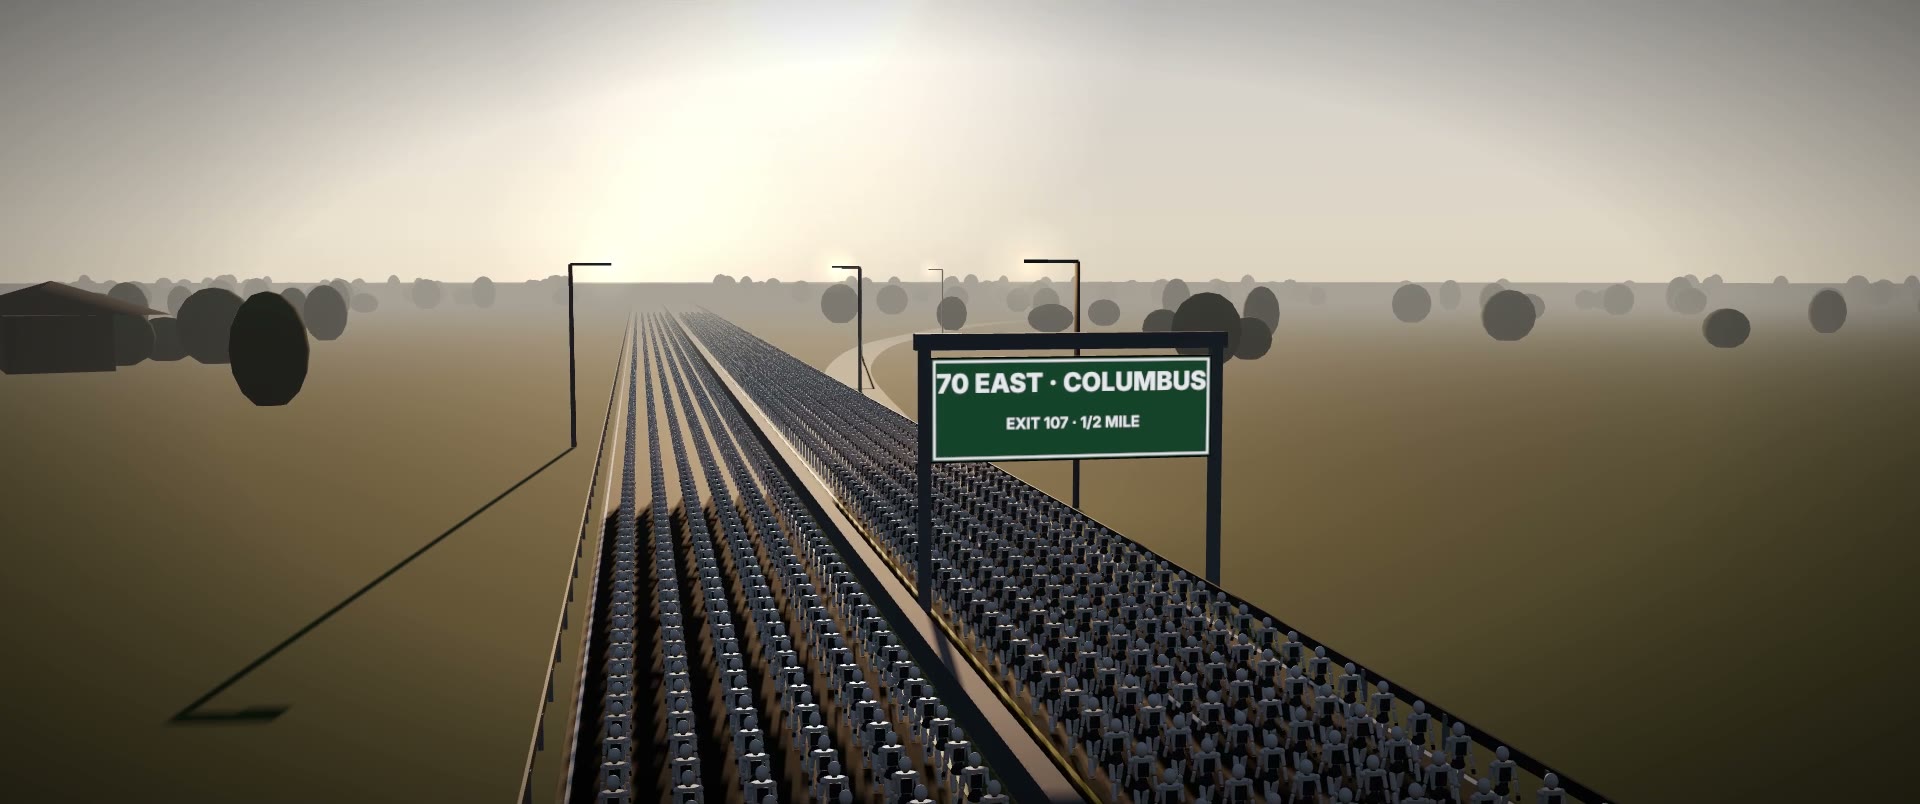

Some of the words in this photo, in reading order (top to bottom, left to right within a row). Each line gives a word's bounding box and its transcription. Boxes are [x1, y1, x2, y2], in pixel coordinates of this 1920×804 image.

[936, 373, 969, 395] 70
[975, 372, 1044, 394] EAST
[1063, 370, 1207, 393] COLUMBUS
[1006, 416, 1041, 430] EXIT
[1043, 416, 1069, 430] 107
[1080, 415, 1102, 430] 1/2
[1105, 415, 1140, 429] MILE
